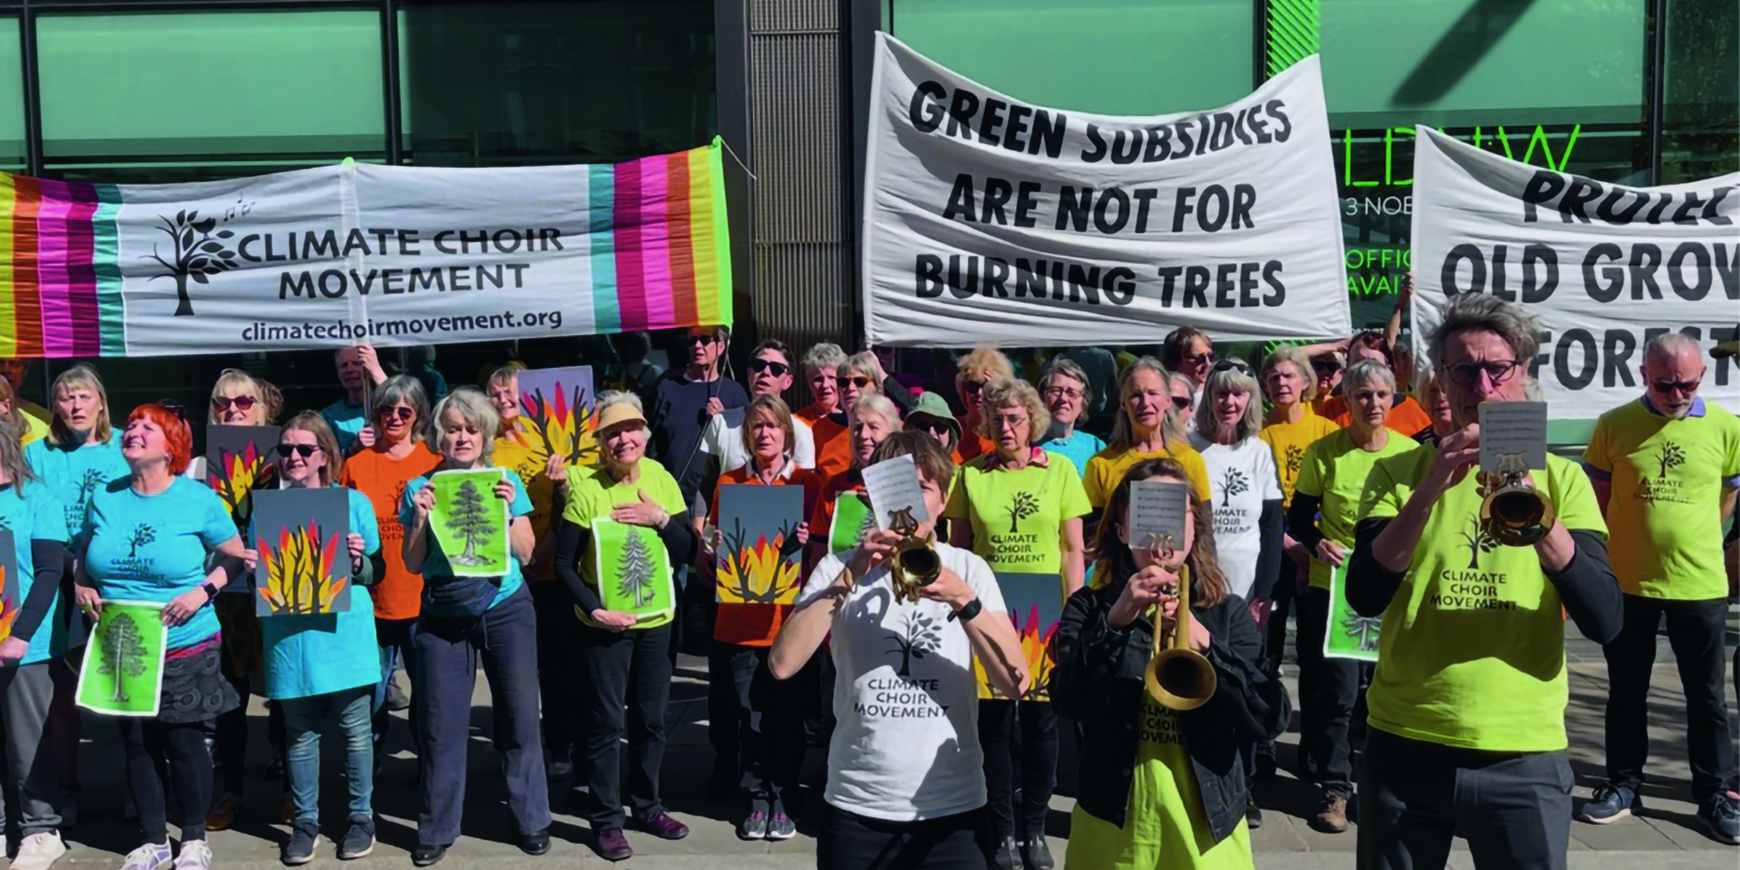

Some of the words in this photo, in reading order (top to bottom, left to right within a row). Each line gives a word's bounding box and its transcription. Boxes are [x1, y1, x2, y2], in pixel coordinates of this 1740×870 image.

[909, 80, 1067, 159] GREEN
[1081, 99, 1291, 164] SUBSIDIES
[943, 173, 1041, 228] ARE
[1055, 185, 1157, 234] NOT
[1171, 183, 1256, 233] FOR
[1346, 197, 1358, 215] 3
[238, 228, 421, 262] CLIMATE
[433, 228, 564, 254] CHOIR
[915, 254, 1136, 306] BURNING
[1158, 260, 1286, 308] TREES
[1441, 243, 1559, 304] OLD
[279, 263, 530, 300] MOVEMENT
[242, 311, 562, 341] climatechoirmovement.org
[991, 534, 1037, 543] CLIMATE
[997, 544, 1031, 553] CHOIR
[985, 554, 1045, 563] MOVEMENT
[1442, 570, 1506, 584] CLIMATE
[1450, 584, 1498, 596] CHOIR
[1430, 595, 1517, 610] MOVEMENT
[868, 679, 939, 690] CLIMATE
[876, 692, 927, 704] CHOIR
[854, 703, 949, 718] MOVEMENT
